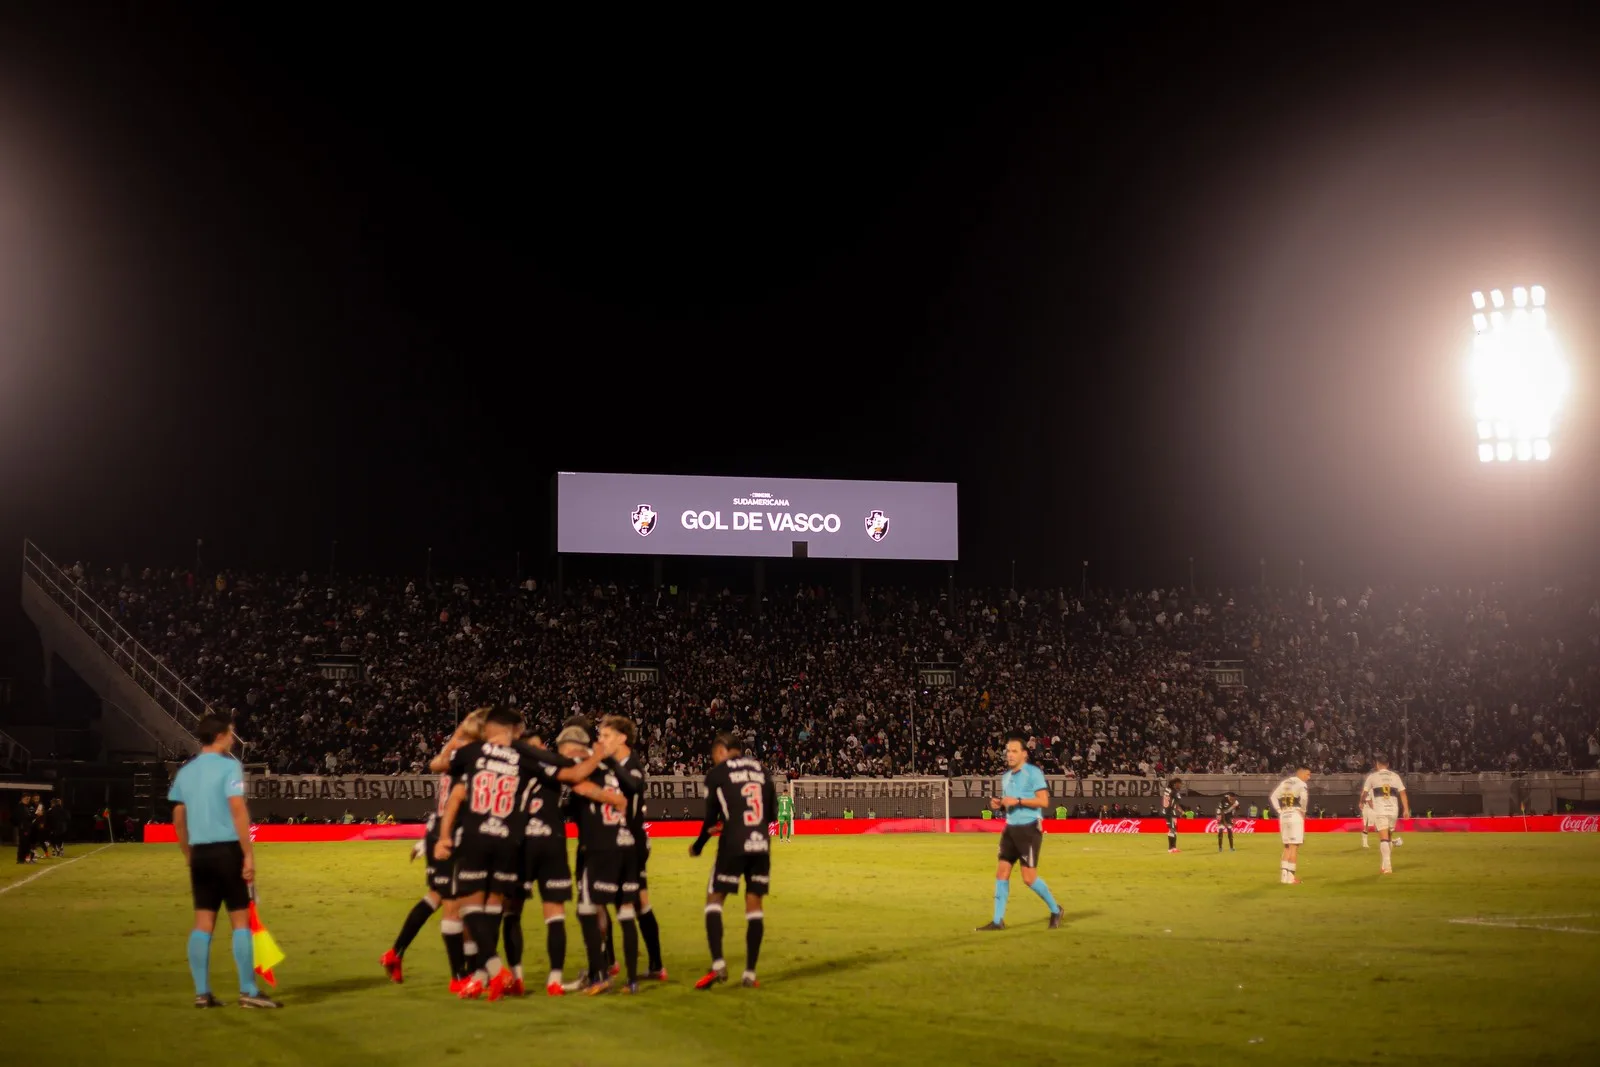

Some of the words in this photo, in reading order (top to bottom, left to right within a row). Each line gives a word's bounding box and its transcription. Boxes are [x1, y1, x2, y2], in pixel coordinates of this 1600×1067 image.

[733, 498, 790, 506] SUDAMERICANA
[681, 510, 728, 530] GOL
[733, 511, 763, 531] DE
[767, 512, 841, 532] VASCO
[255, 779, 346, 799] GRACIAS
[353, 779, 439, 799] OSVALD
[814, 781, 953, 799] LIBERTADORES
[962, 780, 973, 798] Y
[1063, 780, 1084, 798] LA
[1092, 780, 1160, 798] RECOPA
[471, 769, 520, 819] 88
[1382, 784, 1391, 799] 9
[740, 781, 764, 826] 3
[1089, 818, 1142, 833] Coca-Cola
